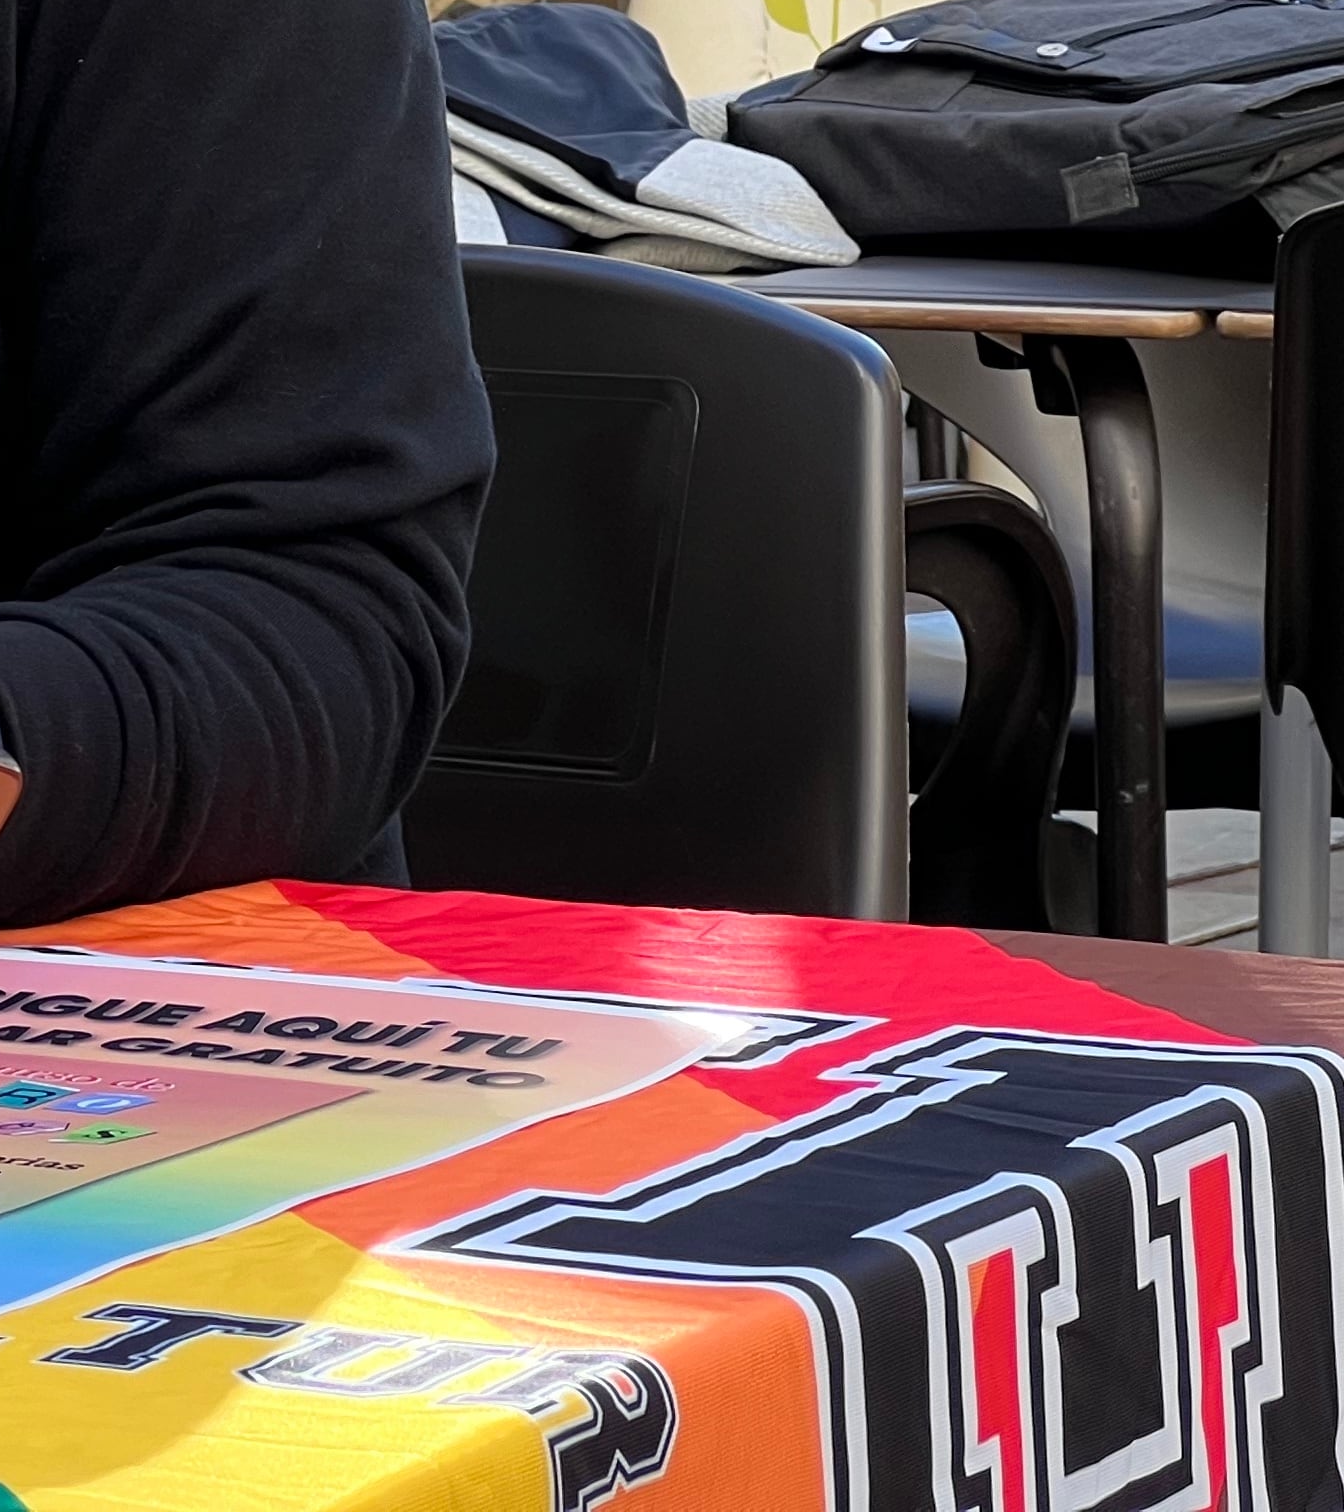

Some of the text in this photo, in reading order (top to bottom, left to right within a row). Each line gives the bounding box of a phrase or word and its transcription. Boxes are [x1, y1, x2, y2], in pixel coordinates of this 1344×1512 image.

[198, 1010, 453, 1050] AQUÍ
[438, 1029, 565, 1060] TU
[100, 1036, 547, 1088] GRATUITO
[111, 1077, 177, 1092] de
